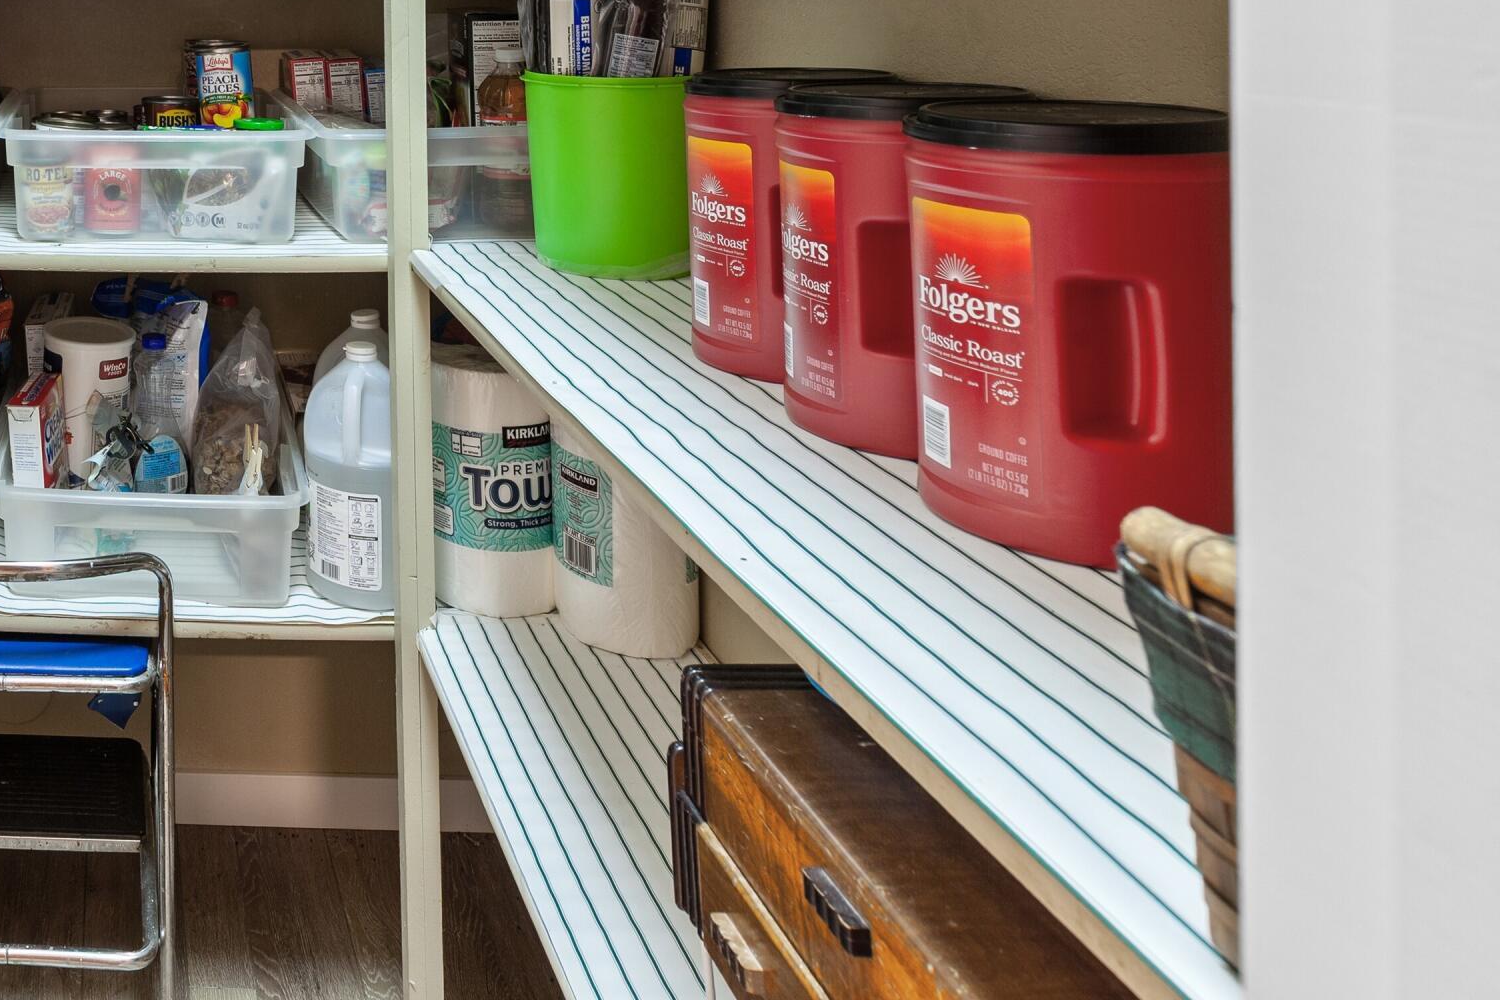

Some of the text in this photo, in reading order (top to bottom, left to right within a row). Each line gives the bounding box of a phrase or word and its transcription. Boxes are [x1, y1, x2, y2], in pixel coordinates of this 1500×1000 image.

[580, 15, 590, 44] BEEF
[206, 55, 230, 68] Libby's
[201, 73, 240, 85] PEACH
[202, 82, 240, 94] SLICES
[159, 114, 197, 128] BUSH'S
[98, 170, 128, 181] LARGE
[691, 191, 747, 223] Folgers
[693, 225, 748, 251] Classic Roast
[800, 272, 831, 295] Roast
[918, 274, 1021, 328] Folgers
[921, 323, 1023, 370] Classic Roast
[103, 362, 126, 373] WinCo
[978, 442, 1029, 467] GROUND COFFEE
[561, 466, 596, 487] KIRKLAND
[981, 461, 993, 472] NET
[993, 465, 1004, 477] WT
[1020, 473, 1029, 485] OZ
[487, 518, 539, 529] Strong, Thick
